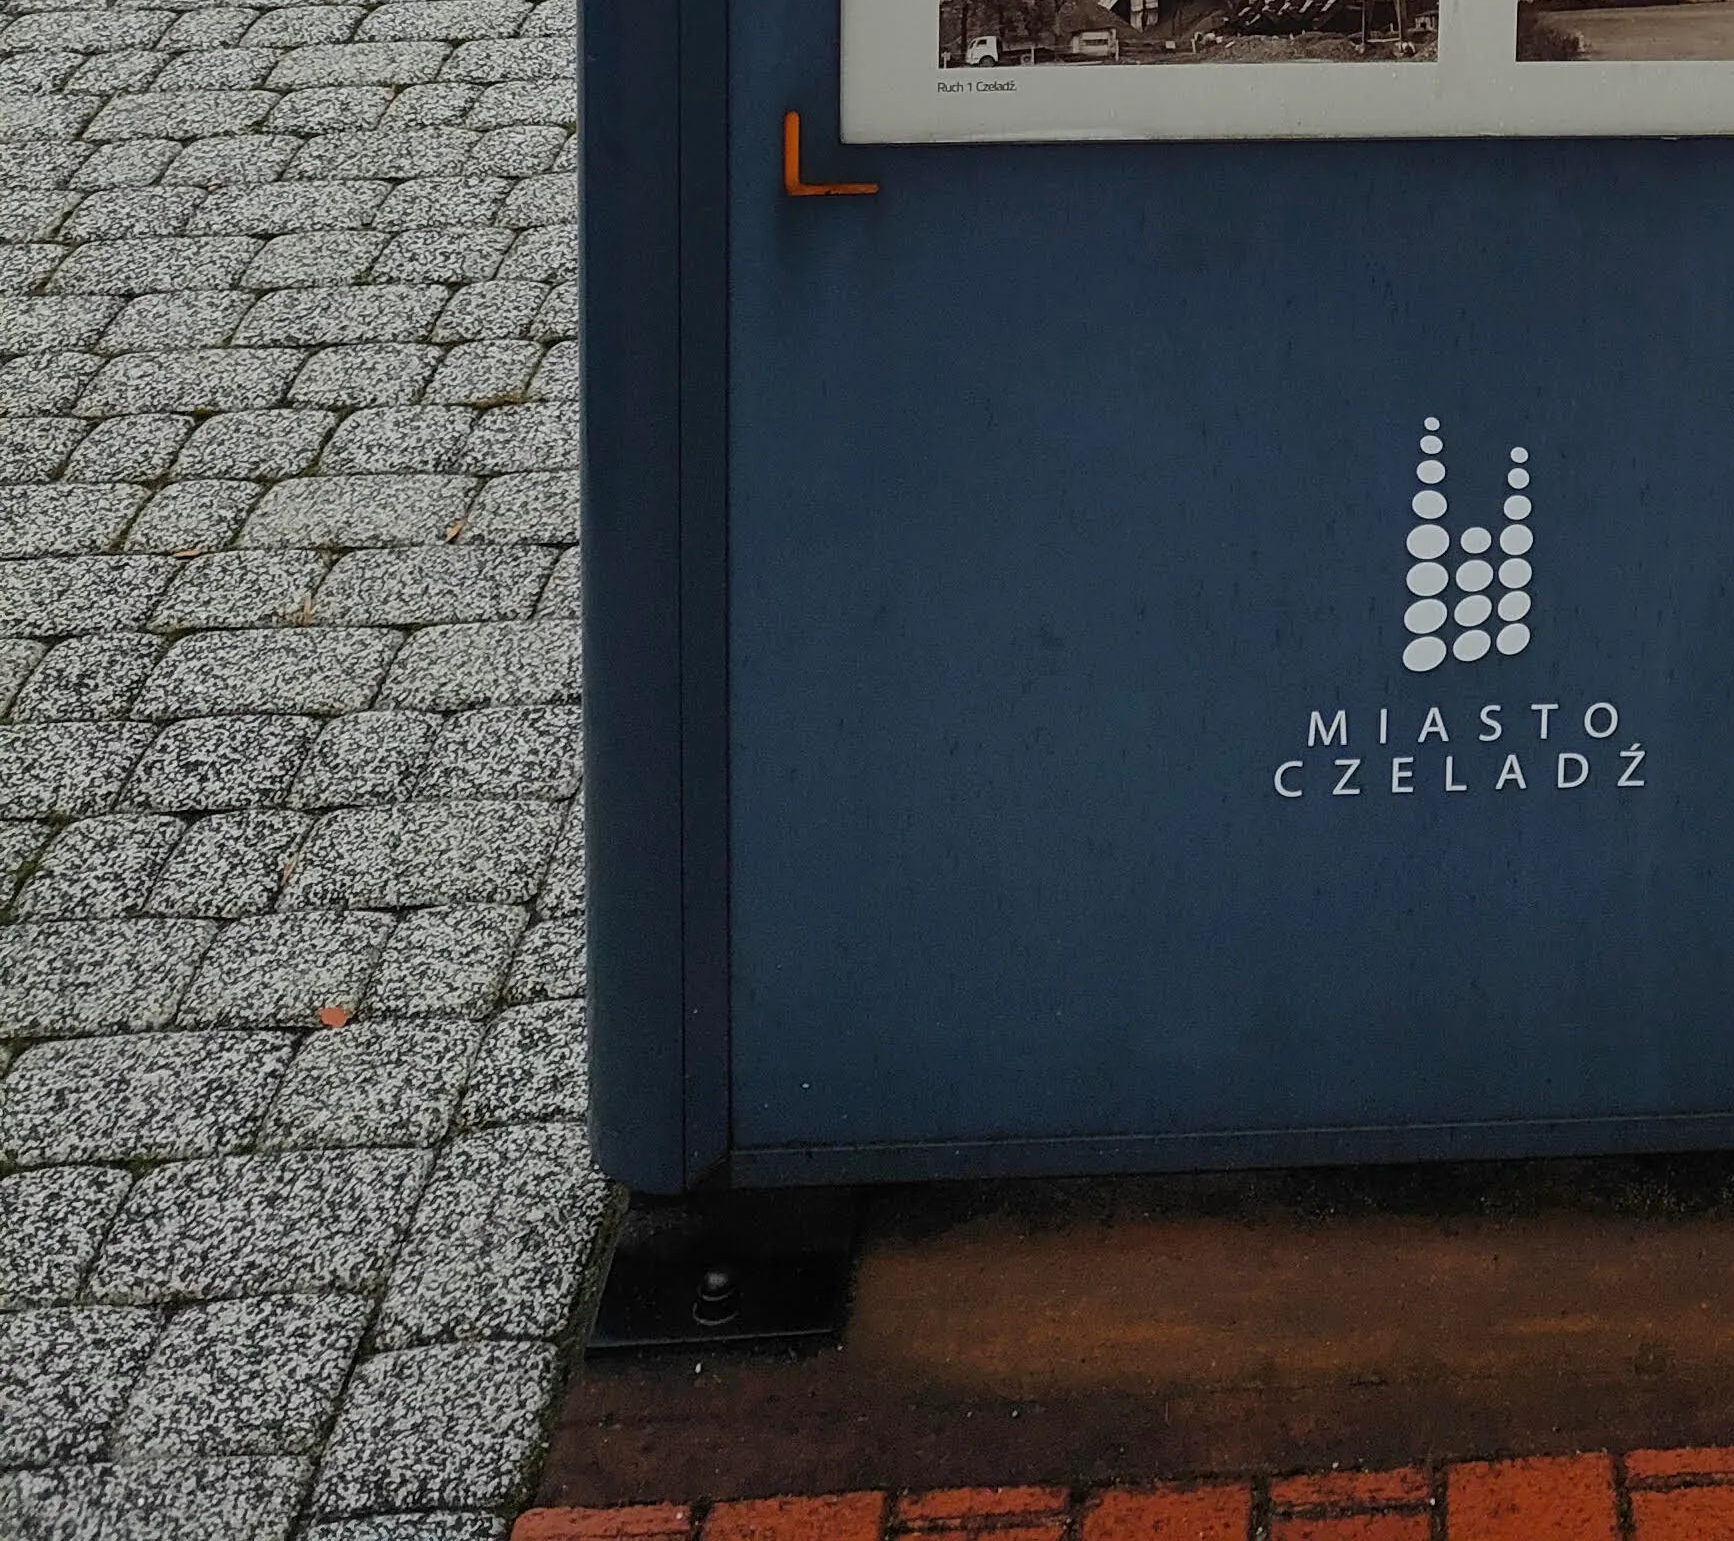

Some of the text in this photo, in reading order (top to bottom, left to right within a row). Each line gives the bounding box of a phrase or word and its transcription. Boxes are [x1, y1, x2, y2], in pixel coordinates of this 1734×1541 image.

[938, 82, 964, 93] Ruch
[976, 81, 1016, 92] Czeladź.
[1308, 703, 1618, 746] MIASTO
[1275, 743, 1645, 797] CZELADŹ
